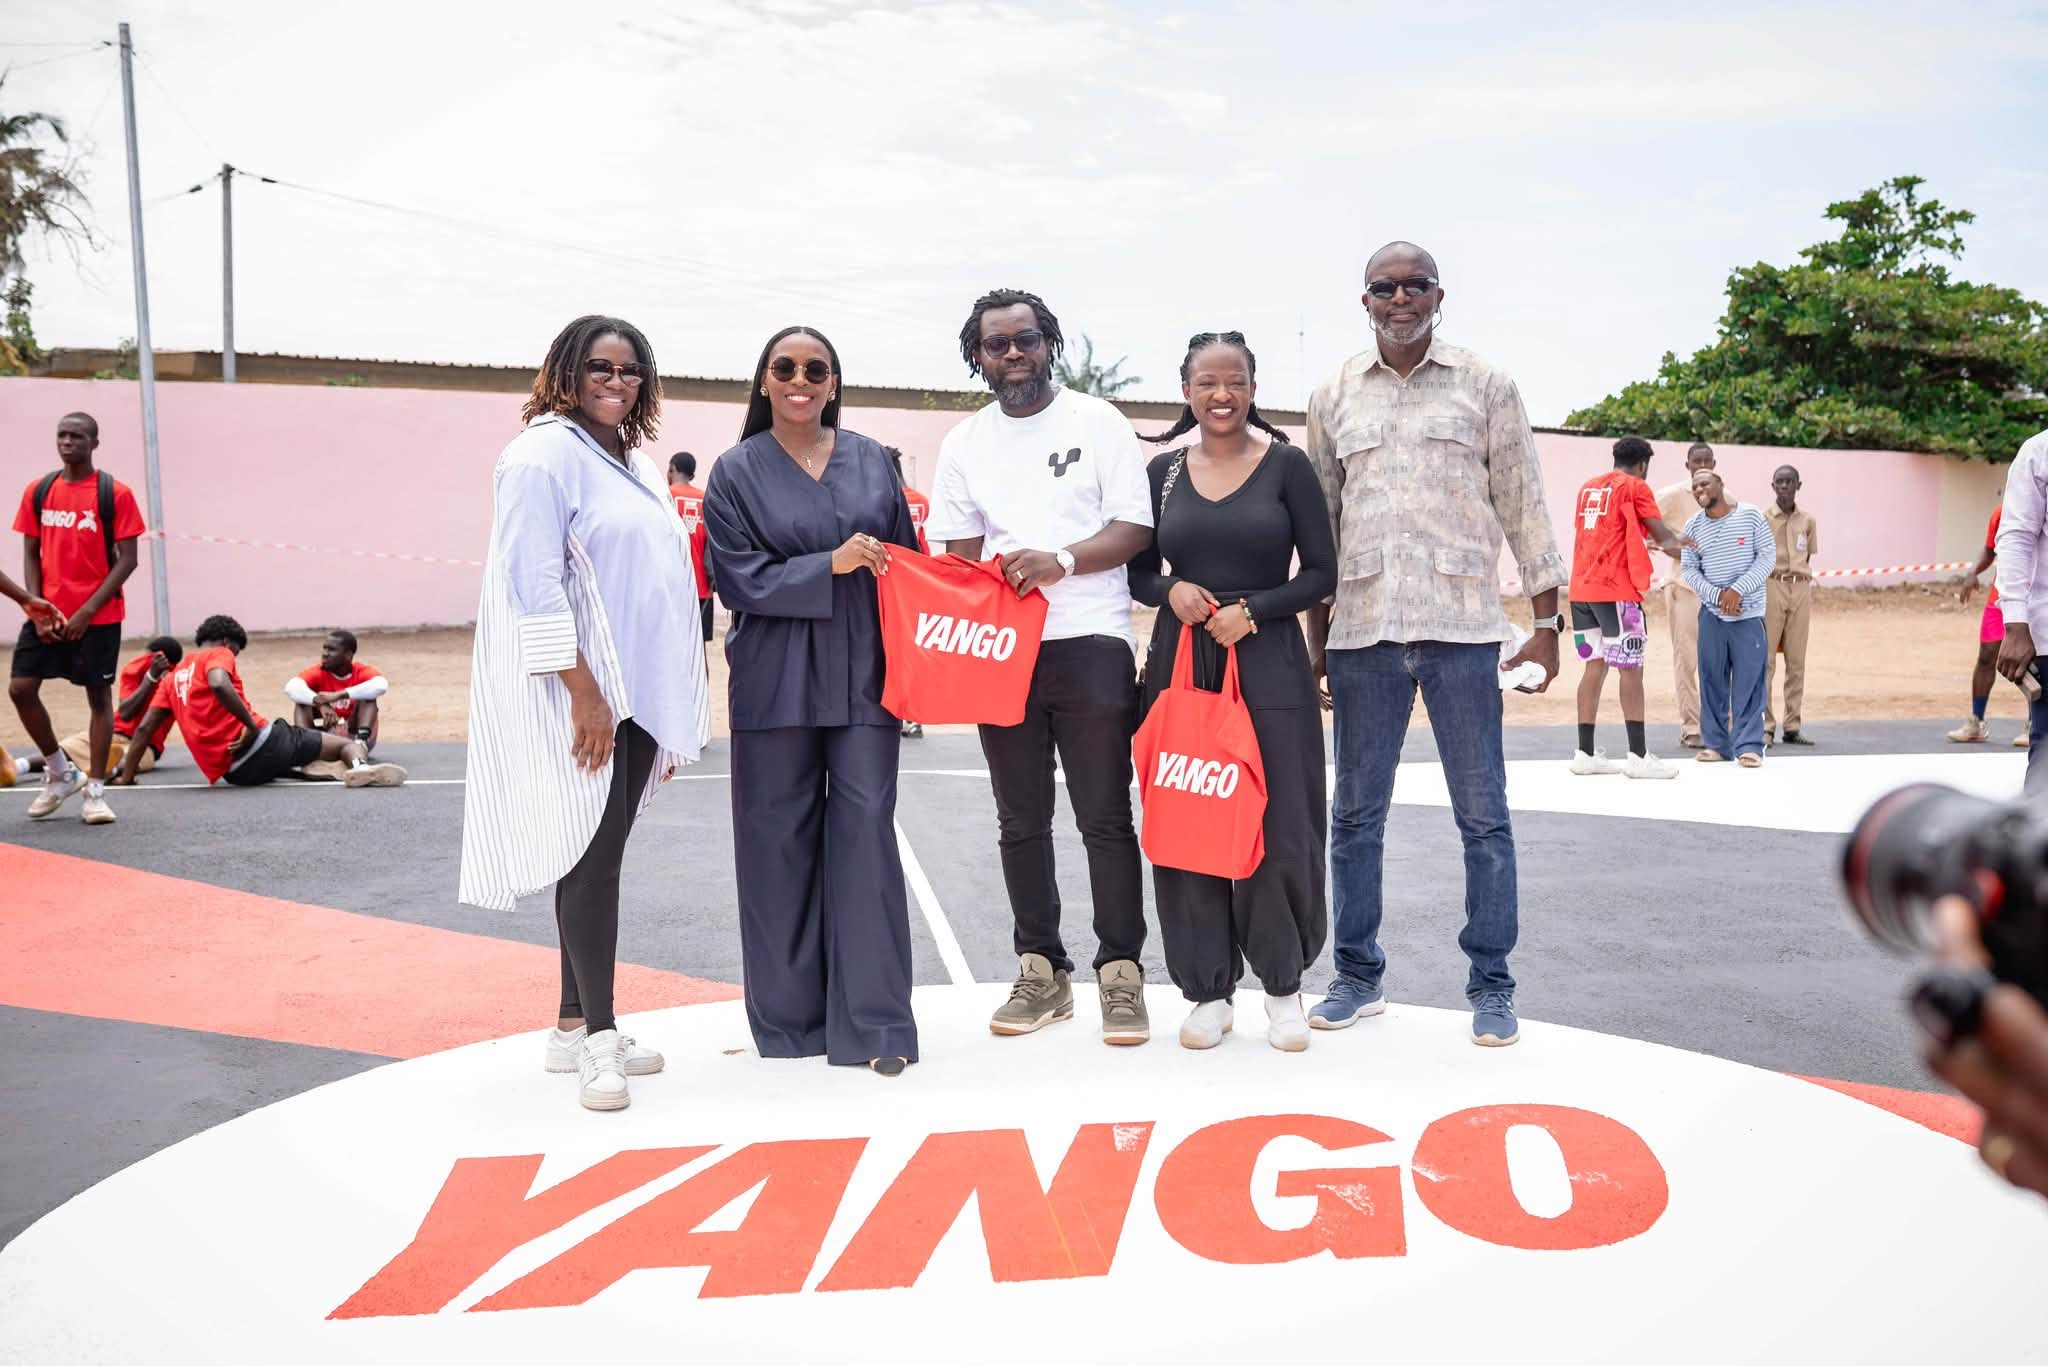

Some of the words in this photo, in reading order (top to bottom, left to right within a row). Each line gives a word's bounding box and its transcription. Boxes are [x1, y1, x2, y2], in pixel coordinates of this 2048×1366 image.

[914, 612, 1017, 662] YANGO
[1153, 751, 1239, 799] YANGO
[324, 1103, 1670, 1321] YANGO
